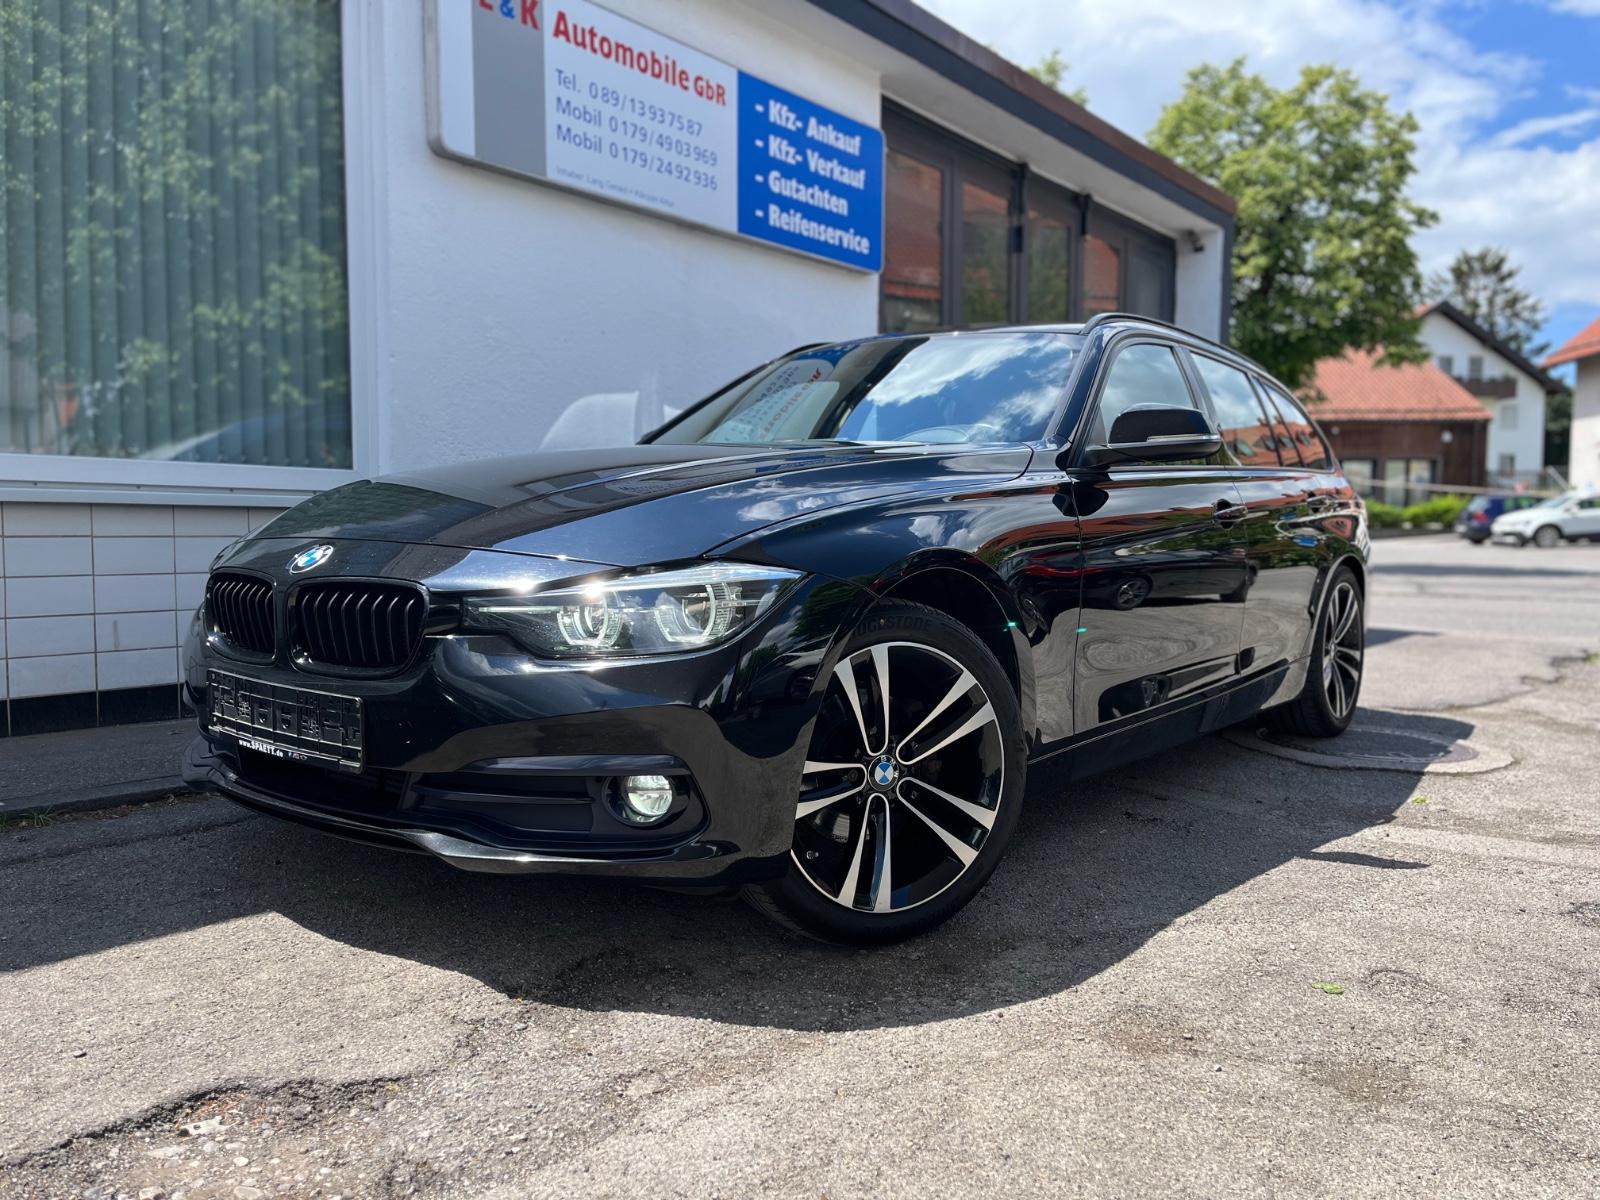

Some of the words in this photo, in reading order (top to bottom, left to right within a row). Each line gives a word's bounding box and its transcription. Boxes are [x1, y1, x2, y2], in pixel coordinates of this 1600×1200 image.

[553, 10, 690, 91] Automobile
[693, 74, 727, 107] GbR
[555, 67, 582, 94] Tel.
[556, 96, 602, 128] Mobil
[556, 124, 602, 154] Mobil
[806, 116, 861, 156] Ankauf
[806, 149, 866, 190] Verkauf
[768, 170, 848, 217] Gutachten
[768, 203, 870, 255] Reifenservice
